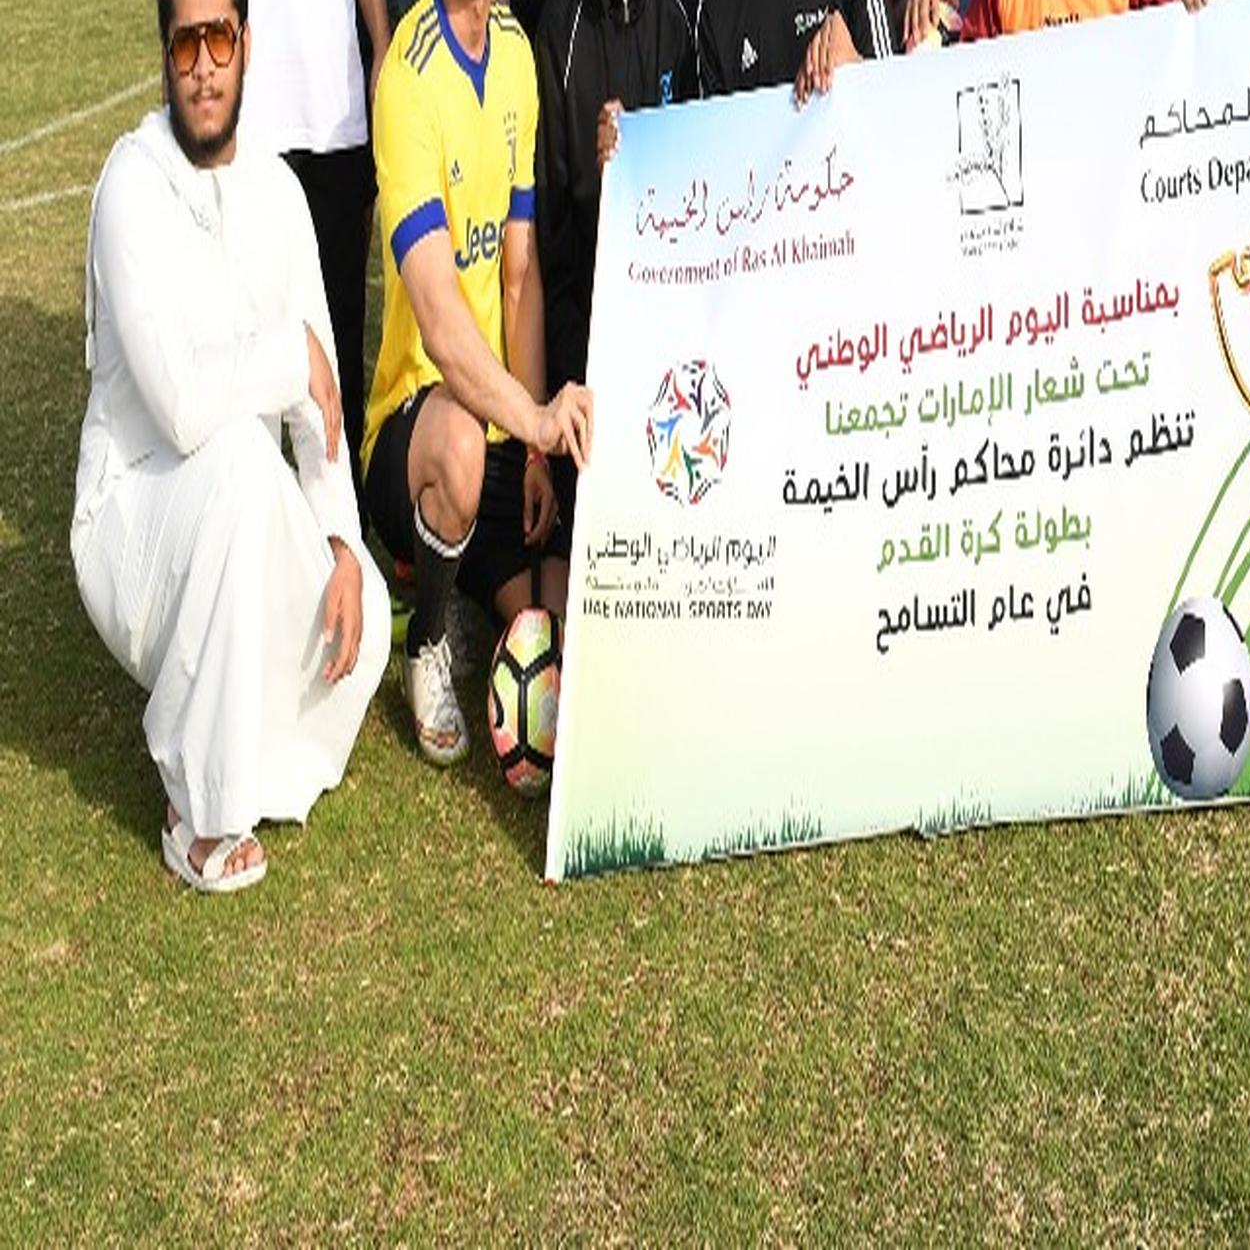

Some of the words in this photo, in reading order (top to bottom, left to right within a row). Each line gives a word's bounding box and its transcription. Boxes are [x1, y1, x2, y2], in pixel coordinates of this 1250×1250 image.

[1140, 165, 1202, 202] Courts
[628, 257, 720, 286] Government
[723, 246, 739, 277] of
[741, 246, 767, 272] Ras
[771, 238, 787, 269] Al
[791, 230, 855, 265] Khaimah
[1005, 291, 1070, 347] اليوم
[1081, 278, 1180, 333] بمناسبة
[796, 322, 888, 390] الوطني
[899, 303, 993, 374] الرياضي
[918, 371, 1013, 428] الإمارات
[1025, 356, 1084, 415] شعار
[1095, 351, 1151, 395] تحت
[825, 393, 908, 439] تجمعنا
[1124, 411, 1196, 467] تنظم
[881, 443, 936, 508] رأس
[949, 437, 1036, 496] محاكم
[1048, 425, 1113, 480] دائرة
[782, 461, 870, 514] الخيمة
[876, 523, 950, 572] القدم
[960, 509, 1002, 565] كرة
[1014, 505, 1092, 549] بطولة
[583, 598, 611, 619] UAE
[614, 599, 682, 620] NATIONAL
[688, 599, 742, 620] SPORTS
[746, 599, 773, 620] DAY
[875, 588, 976, 654] التسامح
[987, 584, 1035, 631] عام
[1046, 572, 1093, 635] في
